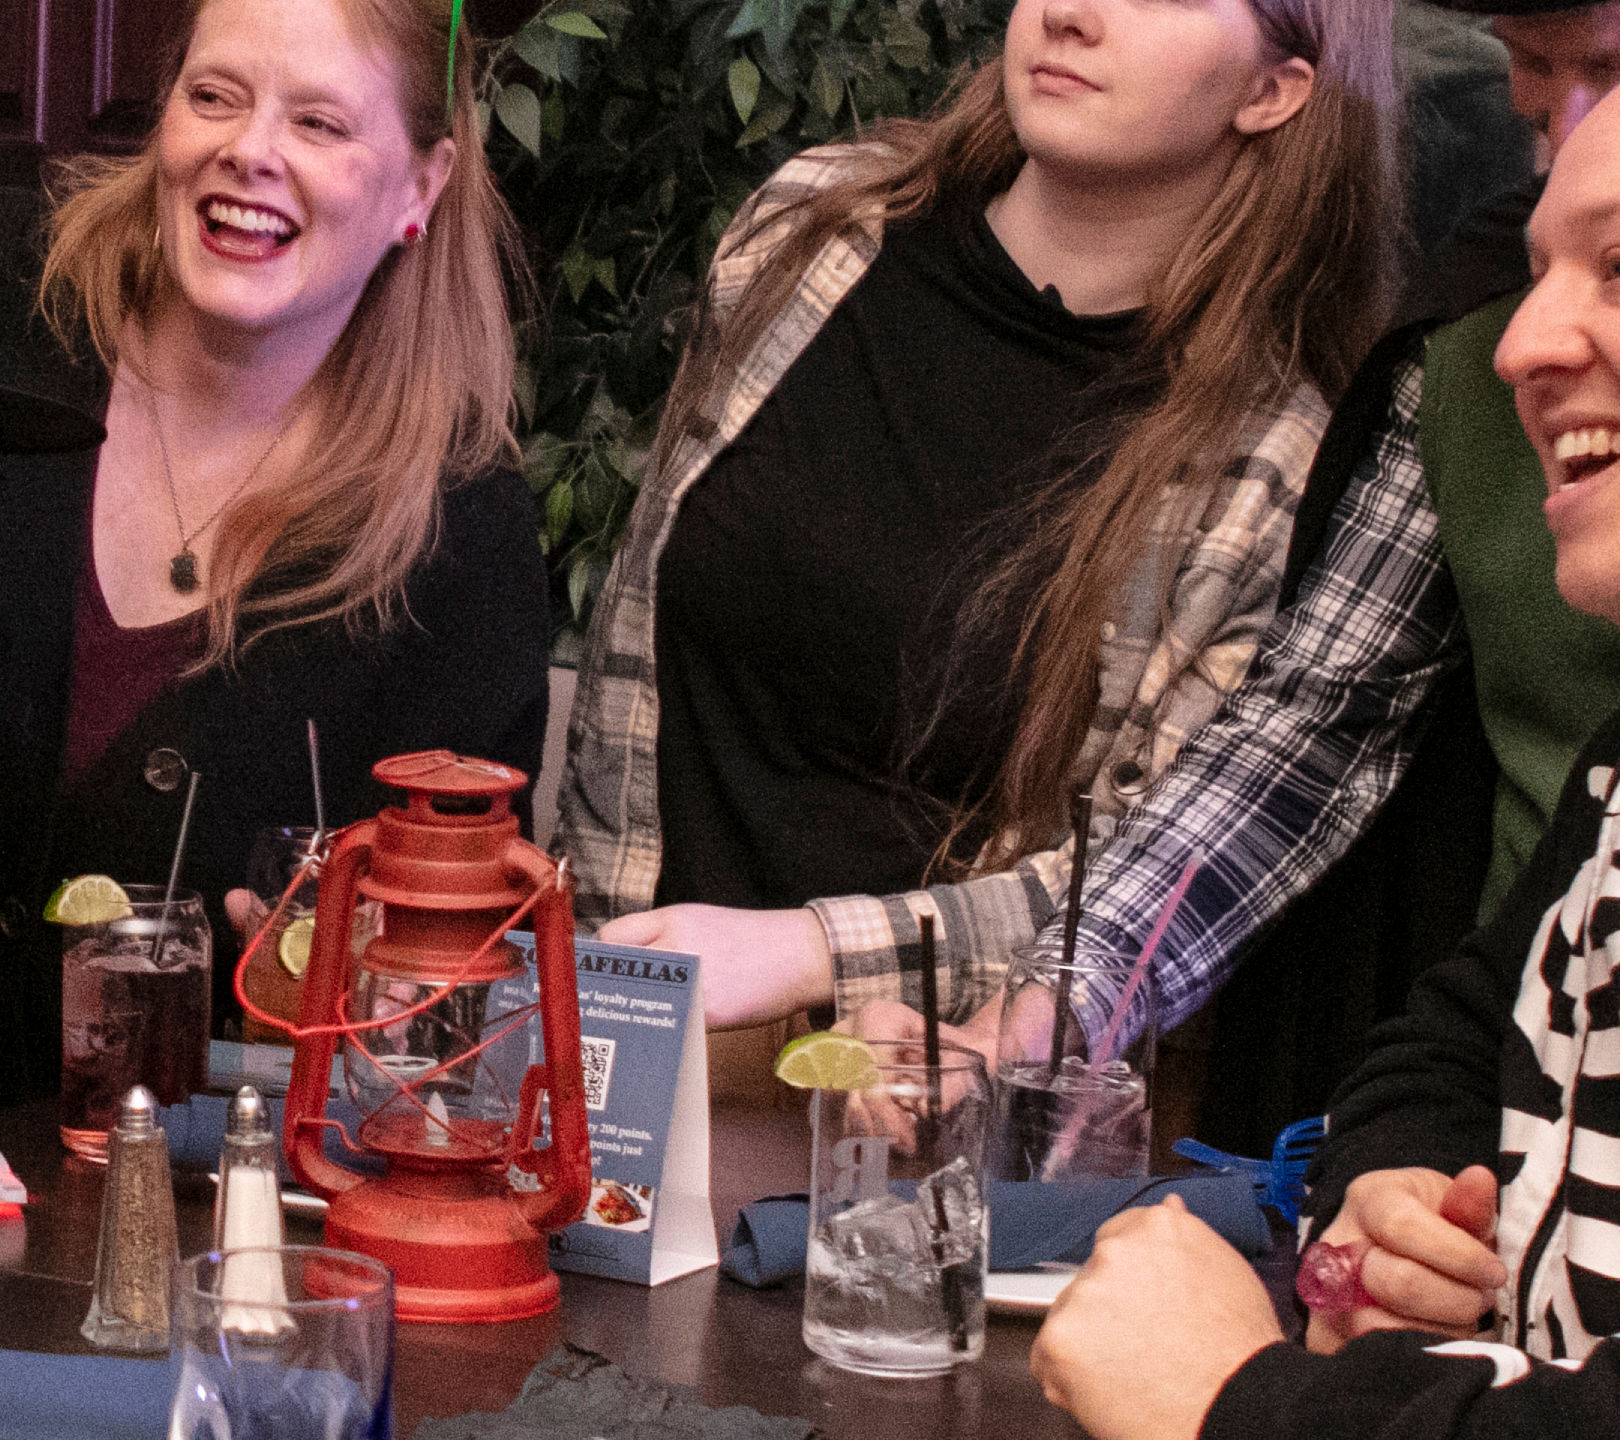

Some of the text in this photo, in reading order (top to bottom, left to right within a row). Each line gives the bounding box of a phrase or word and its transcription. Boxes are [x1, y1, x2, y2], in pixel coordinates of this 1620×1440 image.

[594, 990, 628, 1008] loyalty
[630, 999, 673, 1012] program
[586, 1006, 630, 1022] delicious
[633, 1015, 676, 1029] rewards!
[600, 1123, 617, 1136] 200
[618, 1126, 653, 1141] points.
[621, 1142, 643, 1156] just
